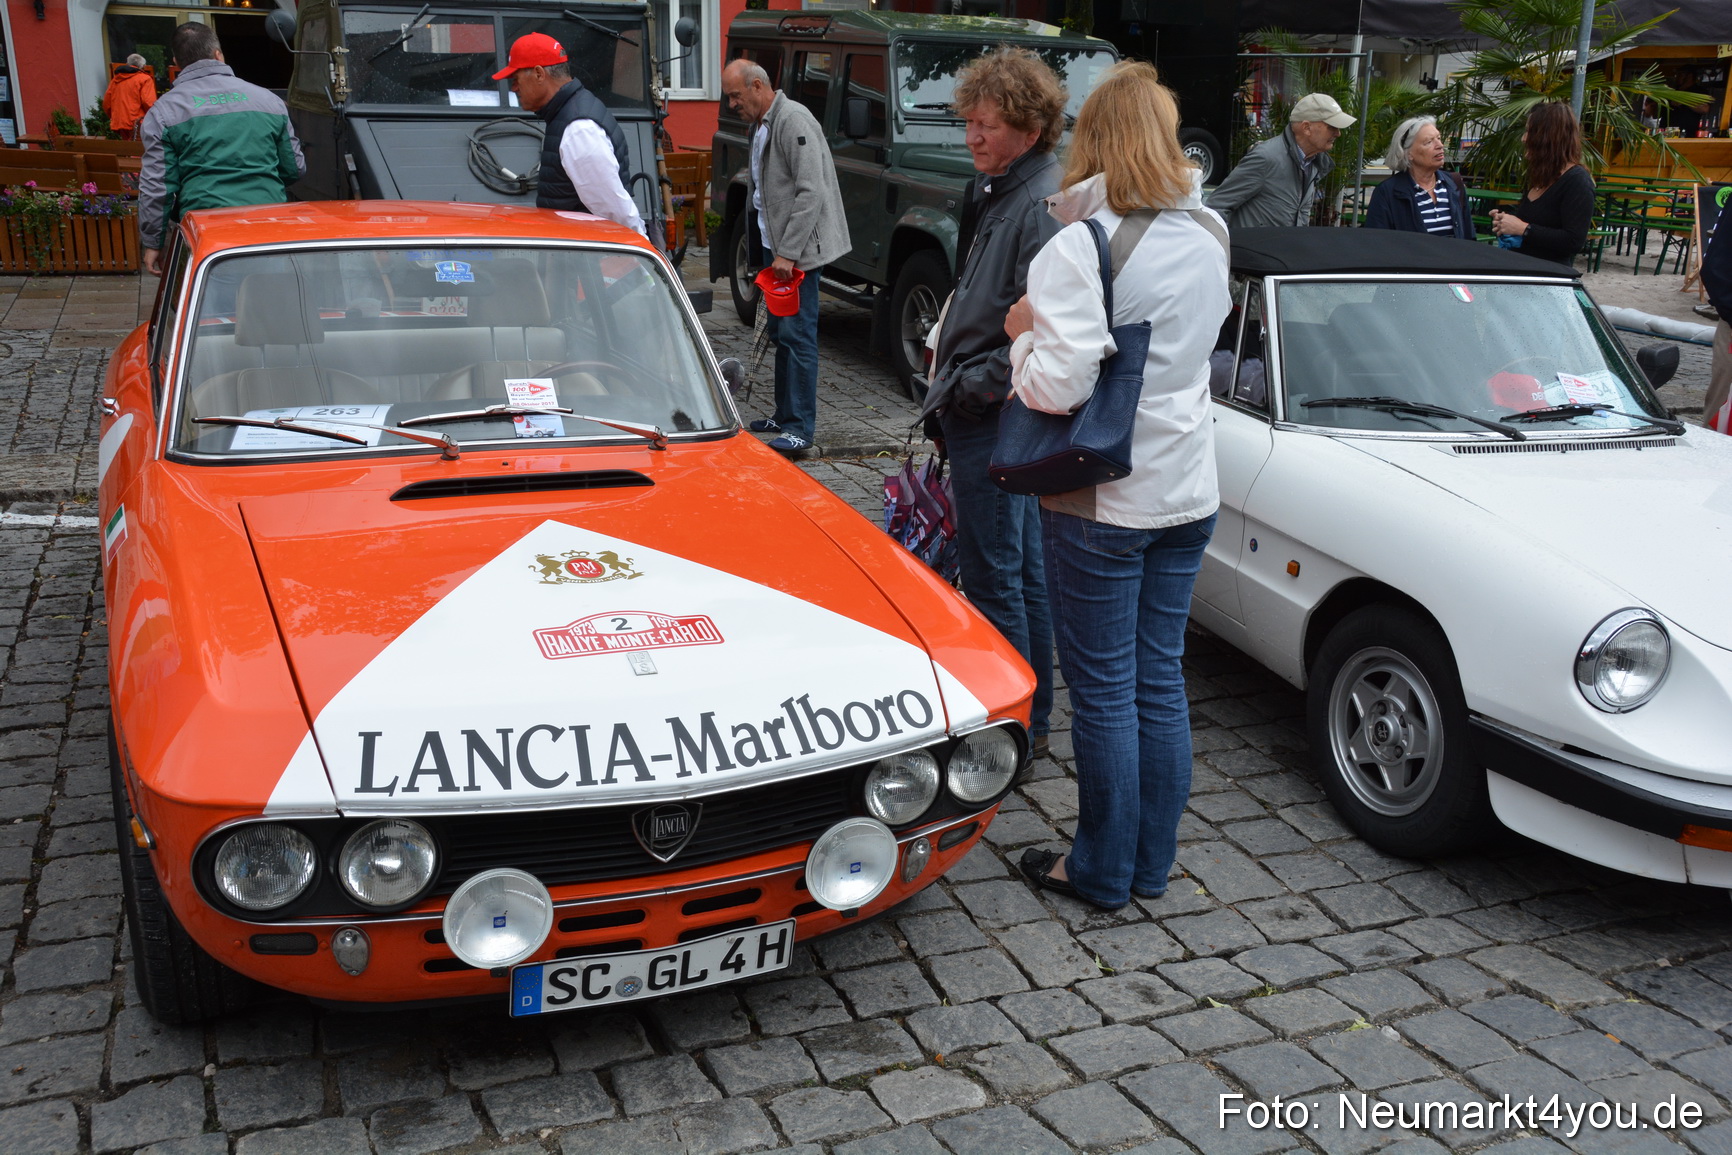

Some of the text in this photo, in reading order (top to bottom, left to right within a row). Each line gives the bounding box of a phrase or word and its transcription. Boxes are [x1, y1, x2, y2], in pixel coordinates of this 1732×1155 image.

[208, 92, 249, 105] DEKRA
[312, 407, 361, 416] 263
[570, 561, 597, 572] PM
[568, 616, 681, 637] 1973 2 1973
[542, 620, 714, 656] RALLYE MONTE-CARLO
[354, 689, 935, 798] LANCIA-Marlboro
[655, 816, 686, 839] LANCIA
[546, 928, 788, 1005] SC GL 4 H
[521, 995, 533, 1007] D
